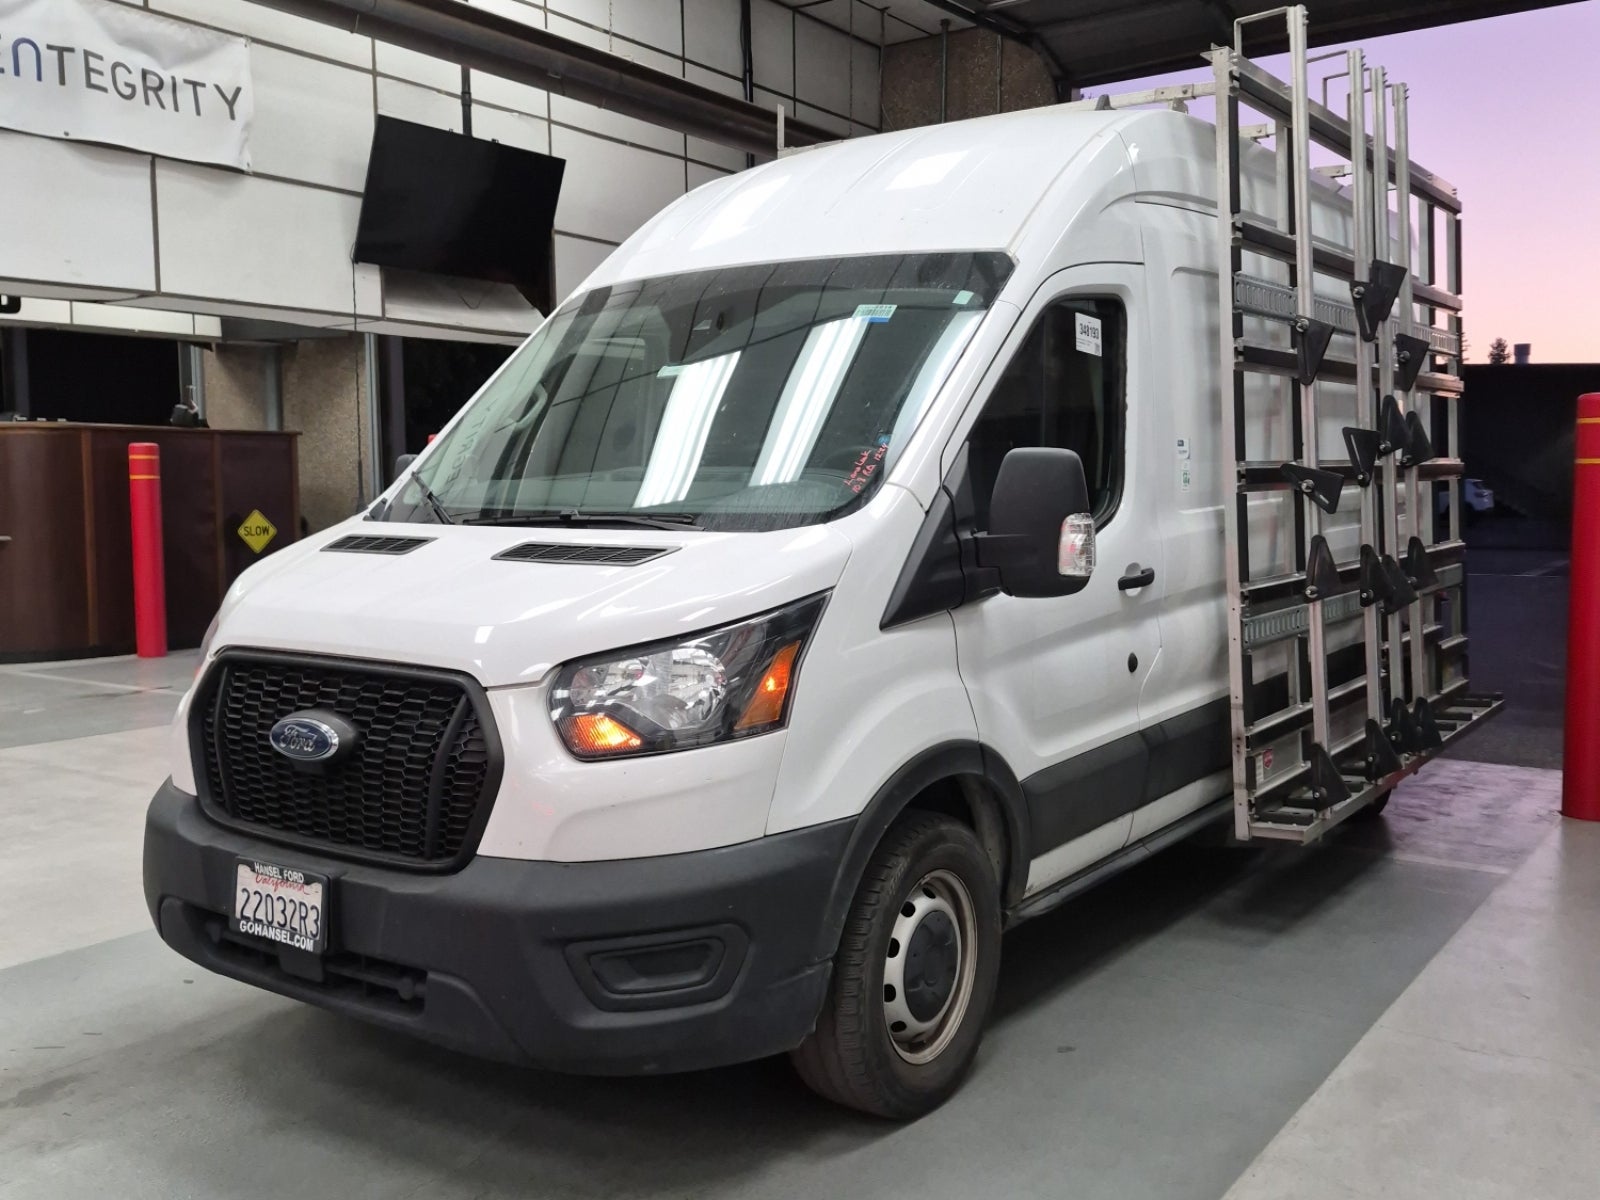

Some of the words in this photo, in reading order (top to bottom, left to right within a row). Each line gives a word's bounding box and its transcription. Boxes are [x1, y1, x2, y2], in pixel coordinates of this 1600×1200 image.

[243, 526, 270, 537] SLOW
[280, 724, 318, 752] Ford
[254, 862, 282, 879] HANSEL
[283, 869, 304, 884] FORD
[240, 887, 320, 938] 22032R3
[239, 919, 314, 952] GOHANSEL.COM
